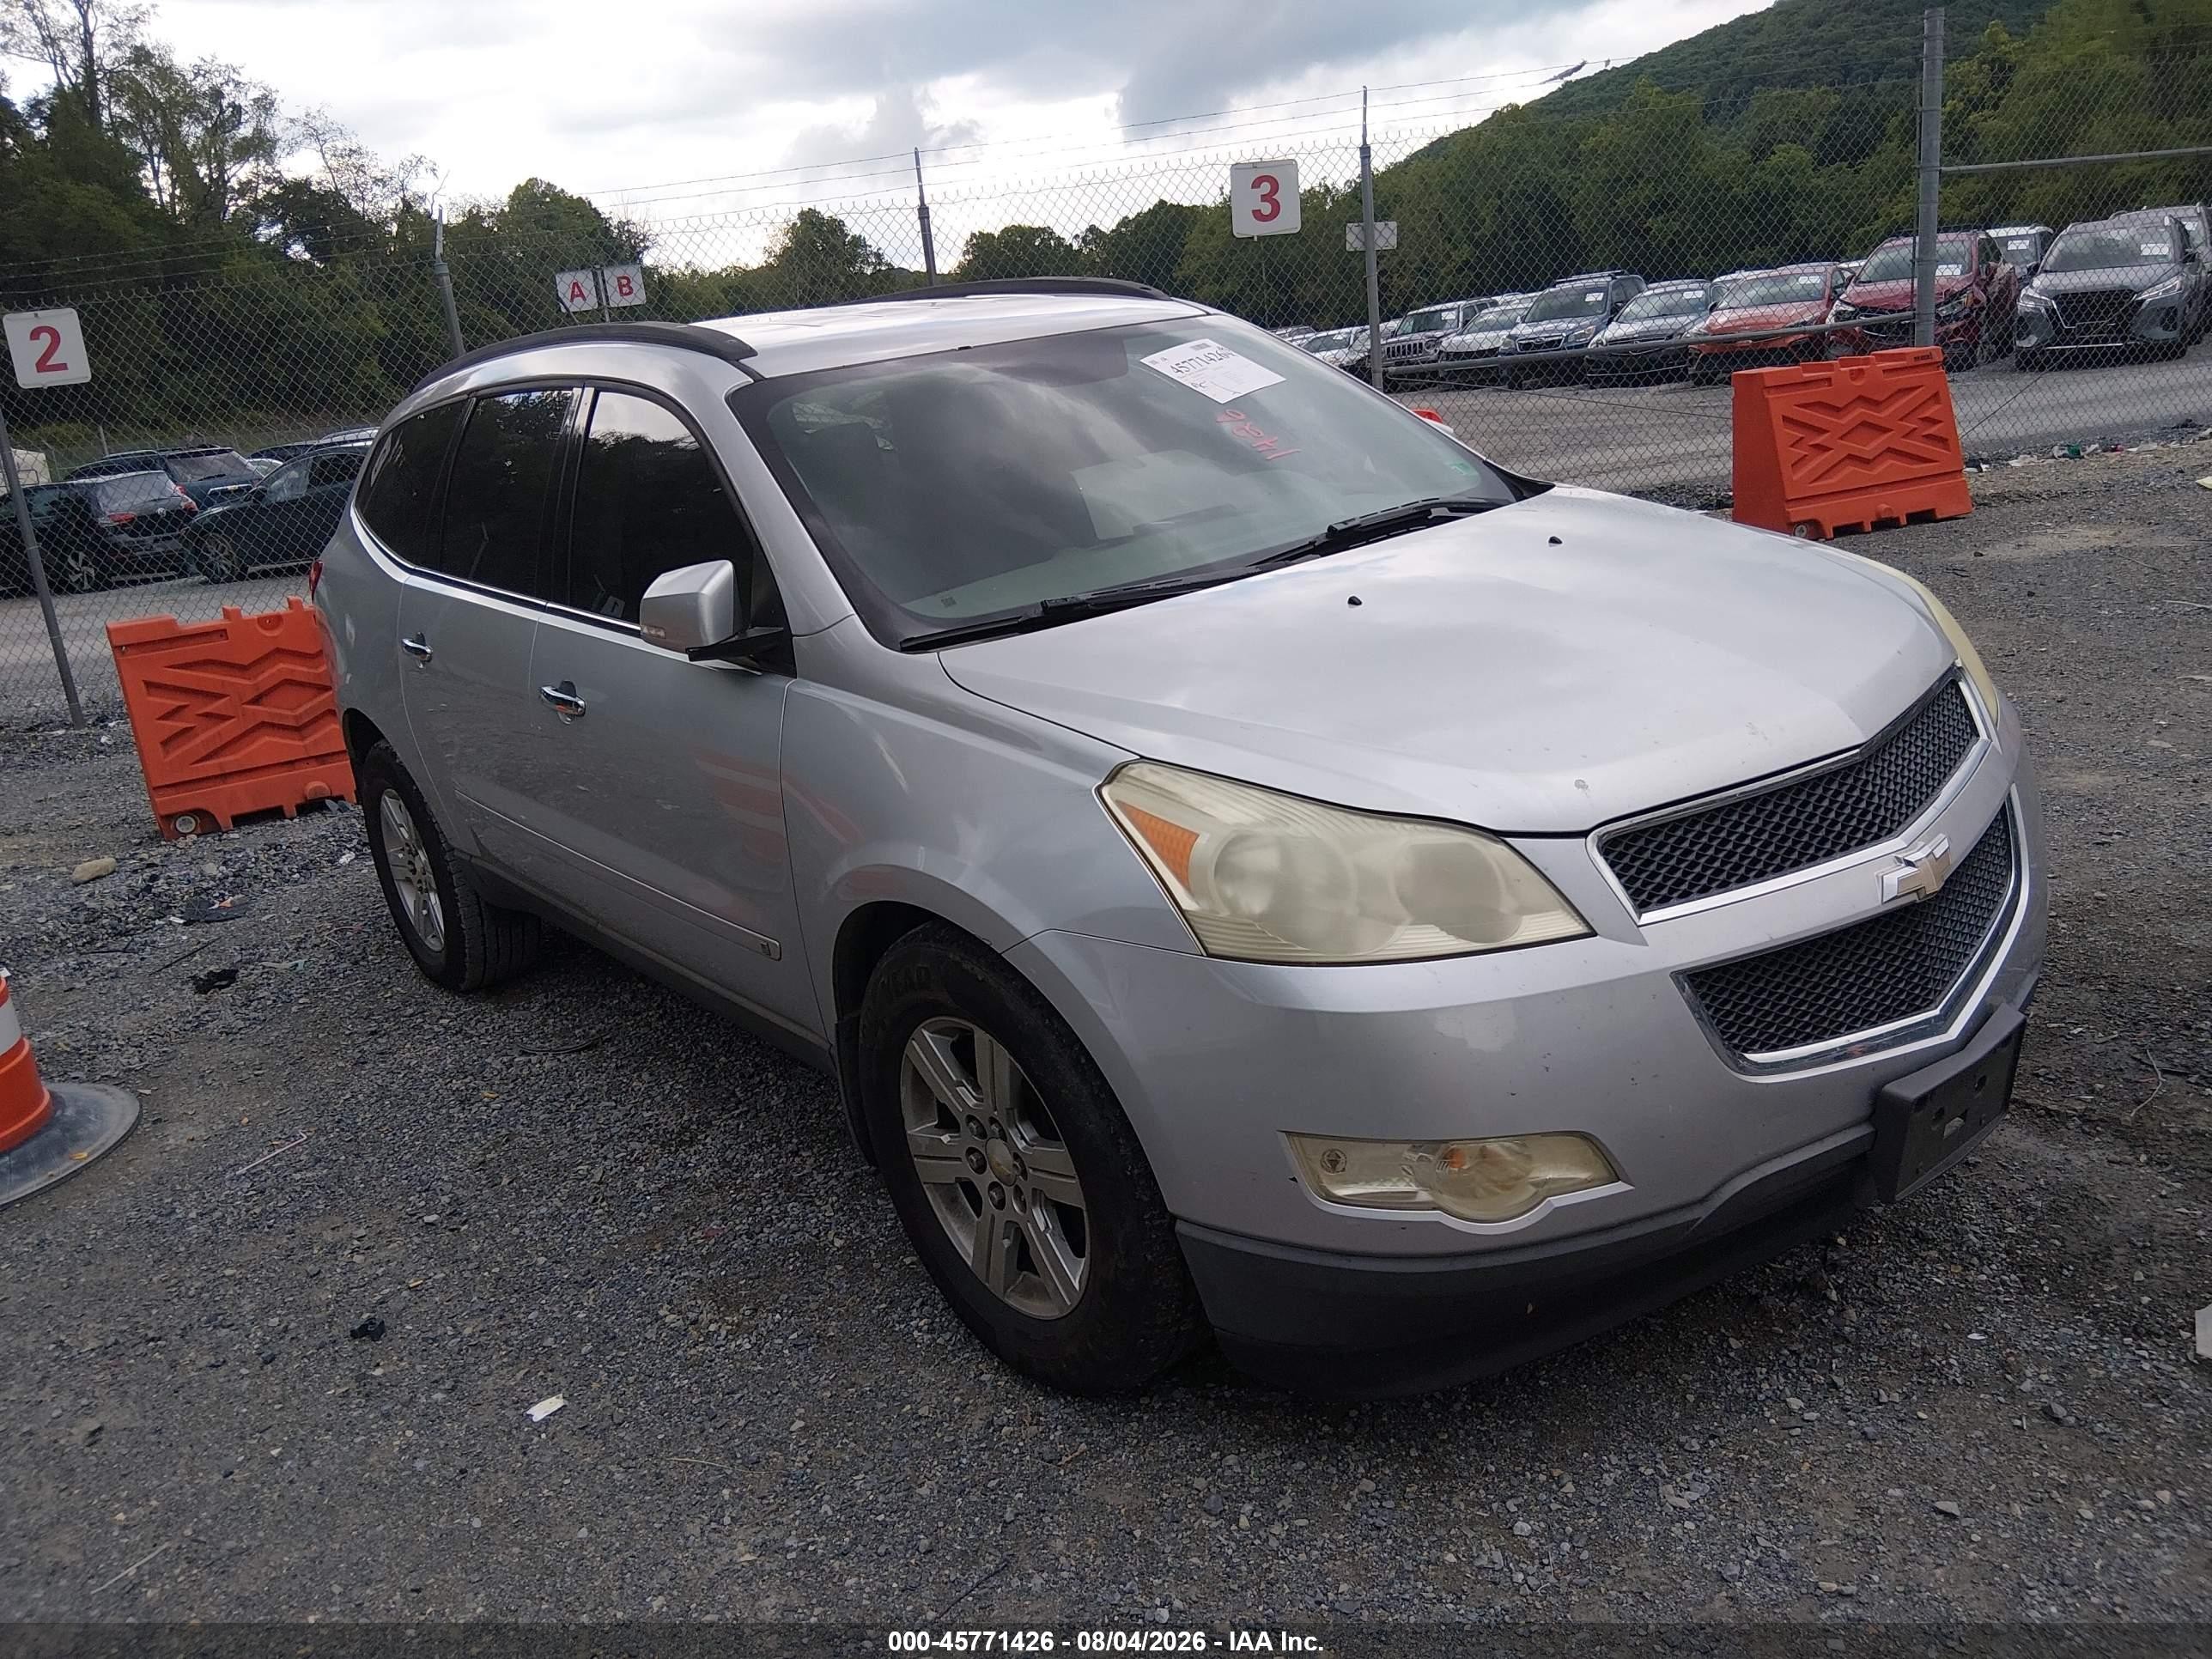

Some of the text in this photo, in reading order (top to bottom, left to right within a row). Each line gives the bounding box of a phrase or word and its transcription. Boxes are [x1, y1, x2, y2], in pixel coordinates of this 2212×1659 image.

[1251, 174, 1281, 222] 3
[569, 281, 586, 302] A
[616, 275, 634, 297] B
[29, 325, 69, 374] 2
